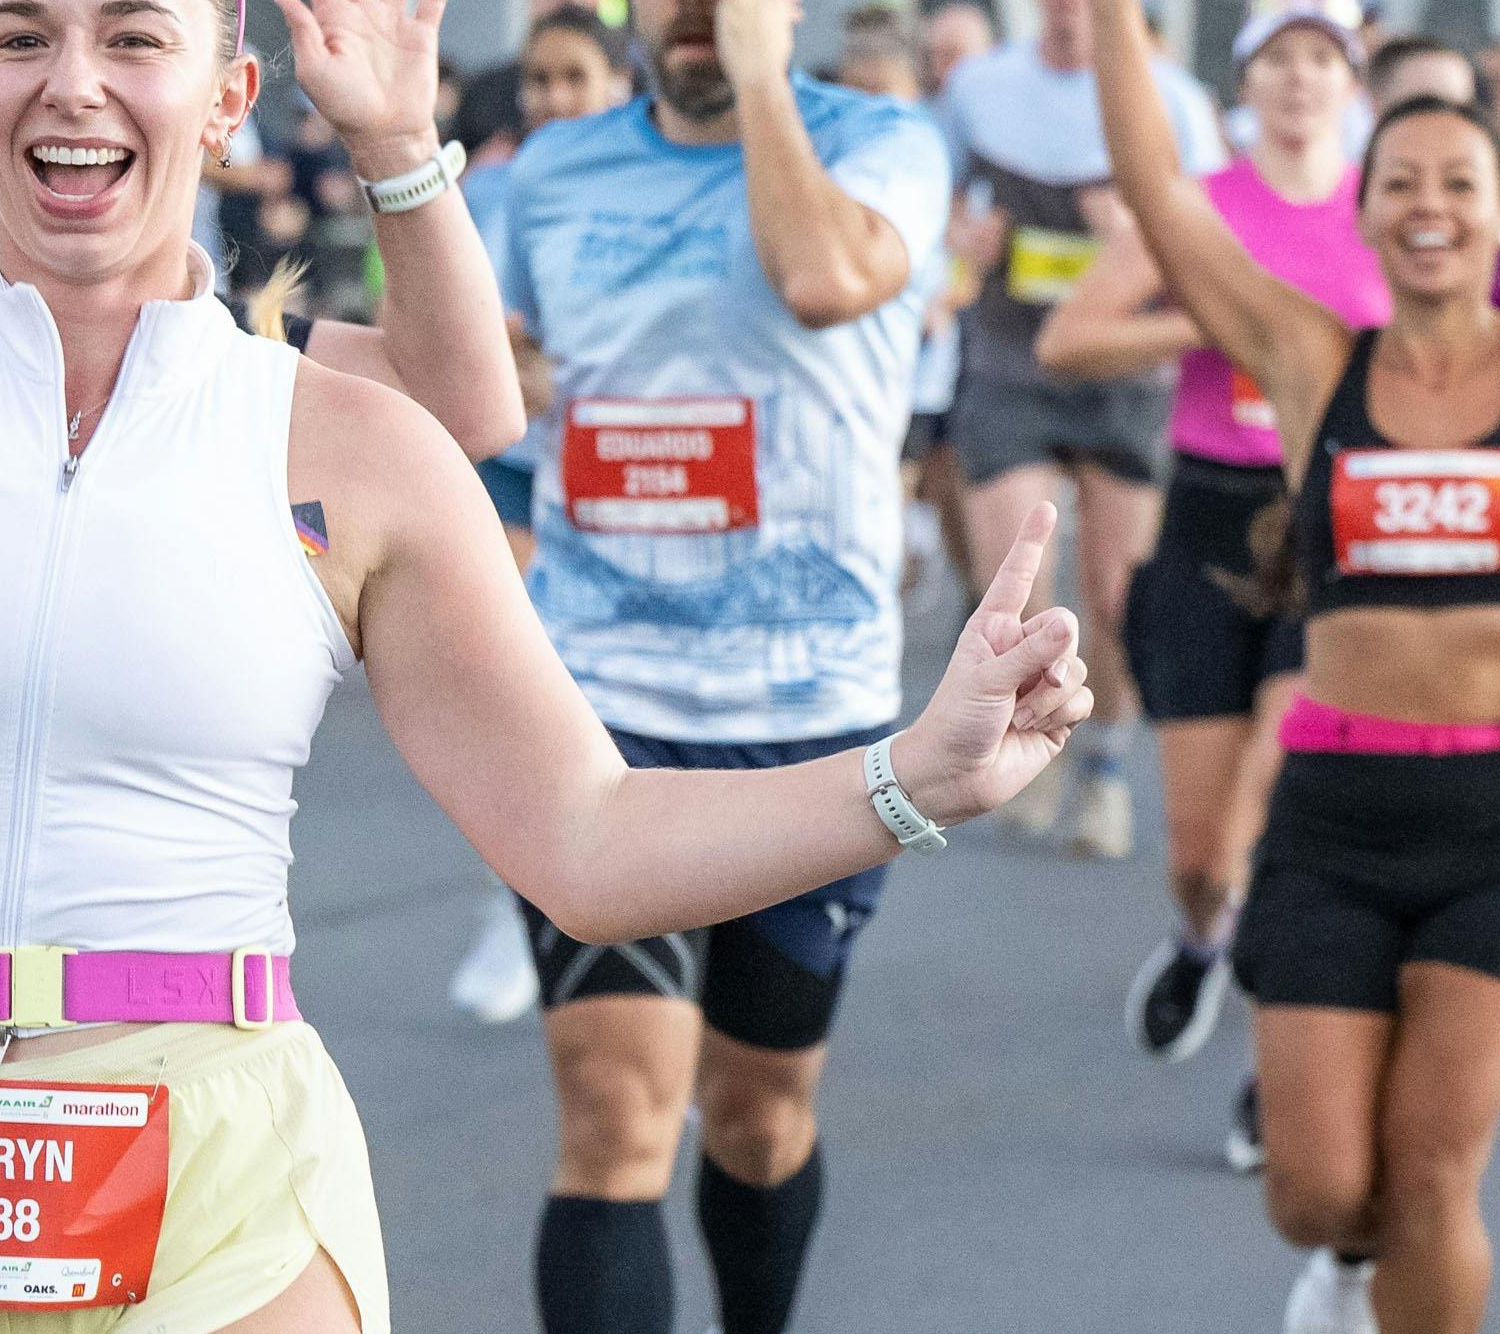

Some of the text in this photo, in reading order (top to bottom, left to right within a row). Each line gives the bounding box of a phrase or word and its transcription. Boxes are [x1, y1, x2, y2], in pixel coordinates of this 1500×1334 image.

[596, 430, 712, 461] EDUARDO
[1374, 480, 1491, 534] 3242
[14, 1099, 36, 1108] AIR
[63, 1102, 139, 1117] marathon
